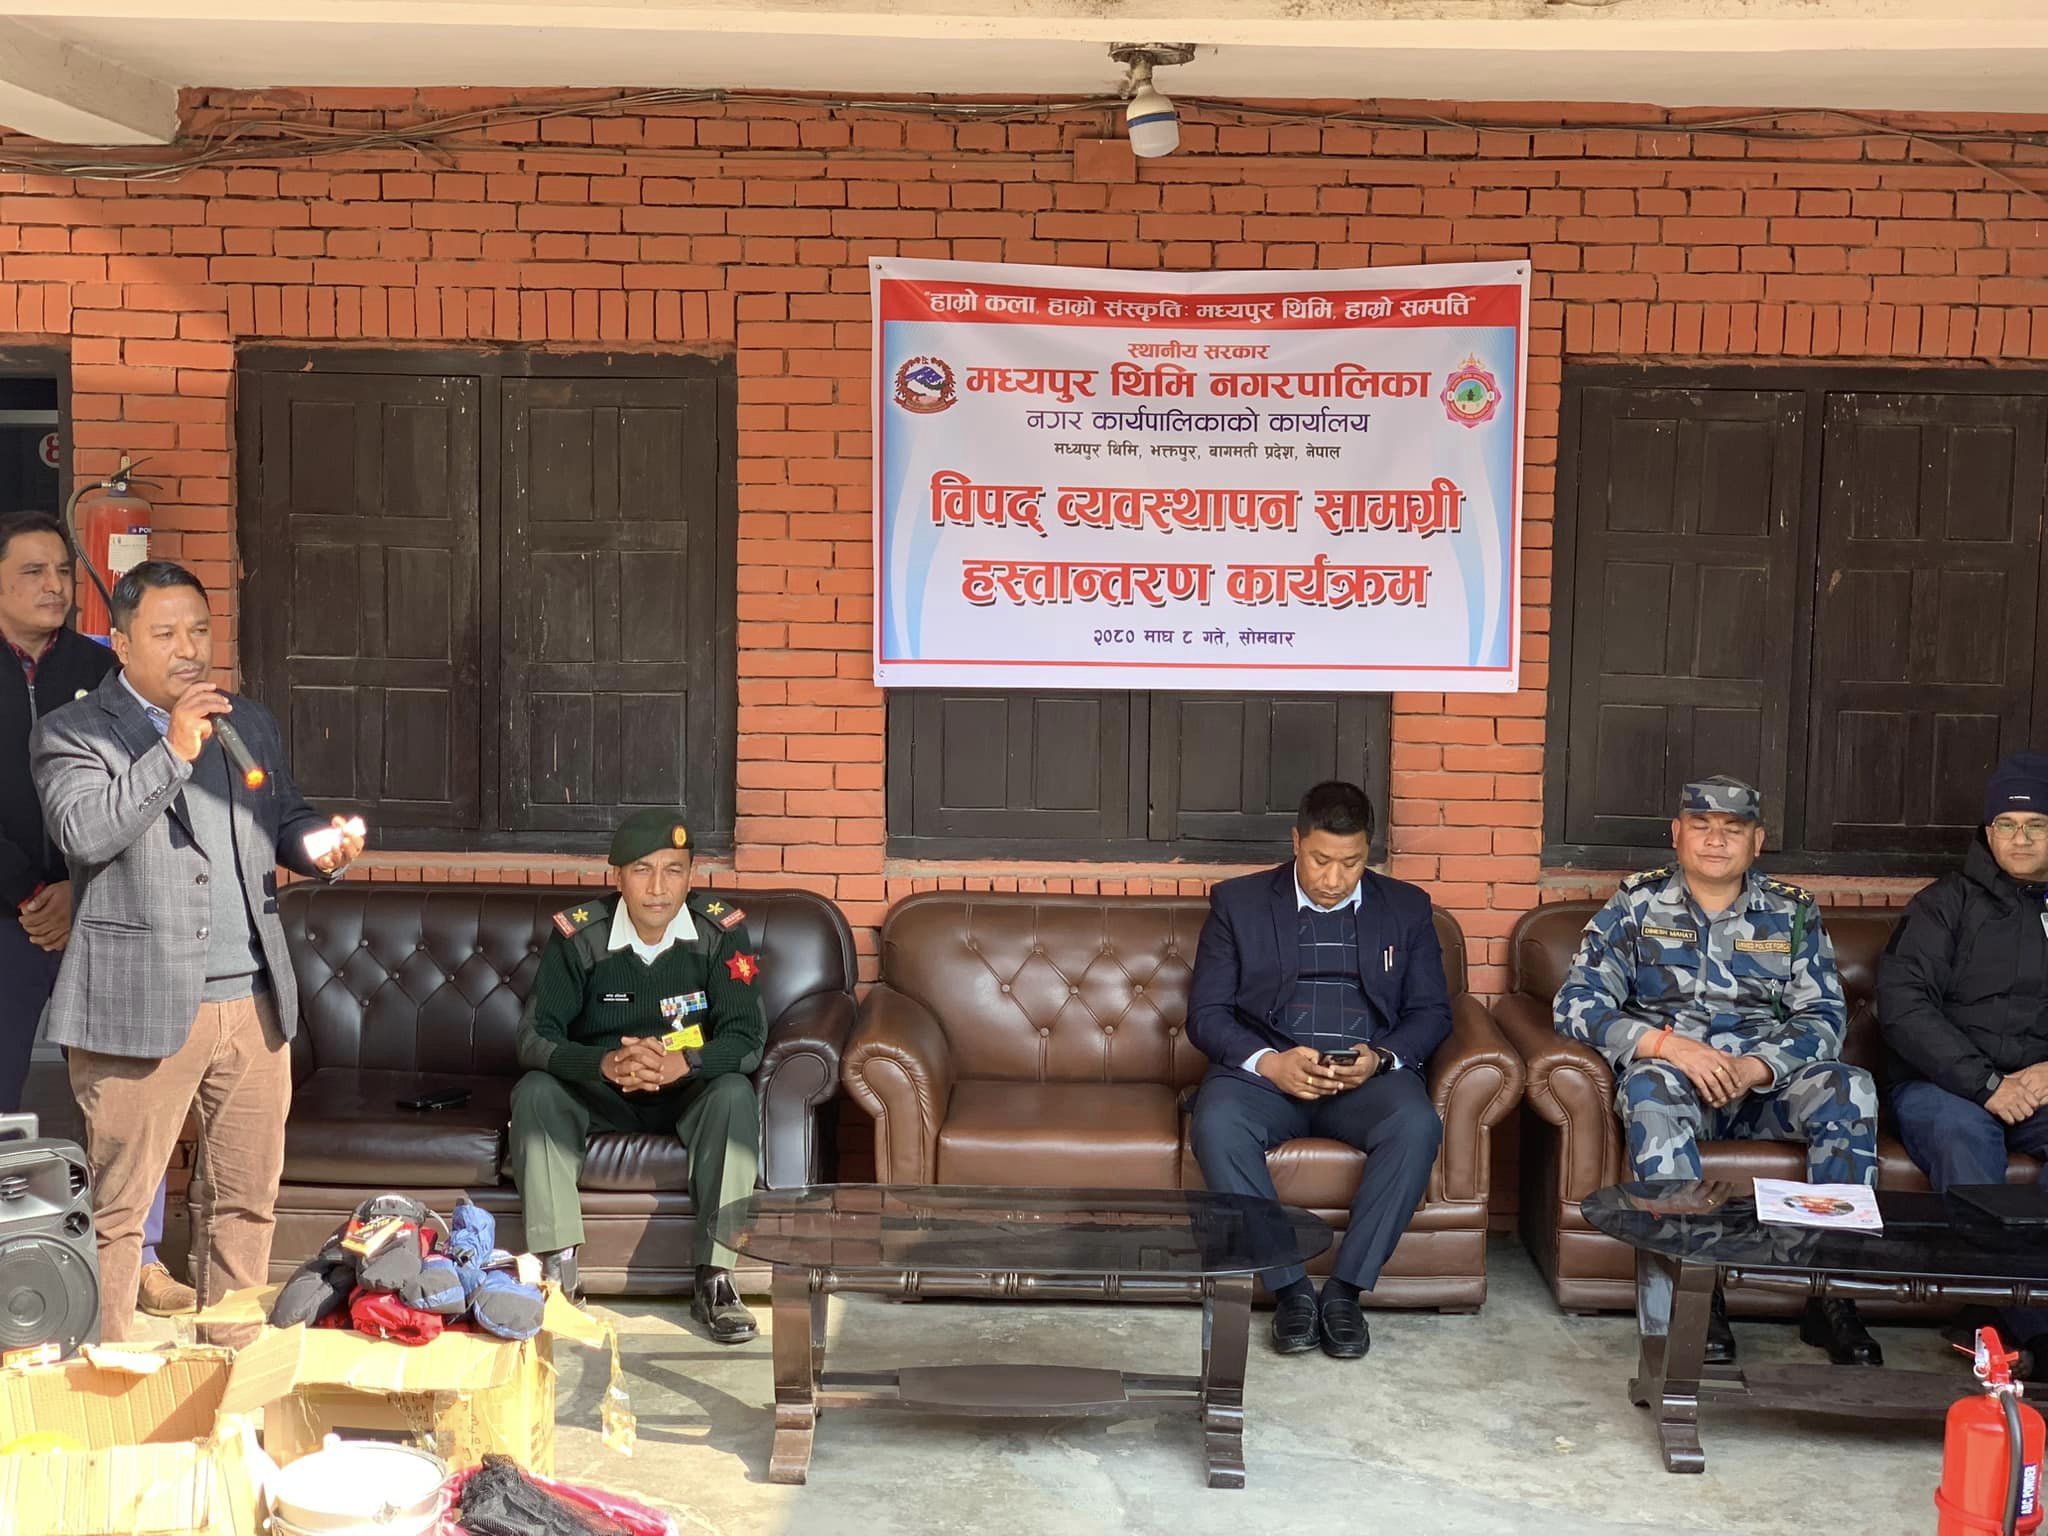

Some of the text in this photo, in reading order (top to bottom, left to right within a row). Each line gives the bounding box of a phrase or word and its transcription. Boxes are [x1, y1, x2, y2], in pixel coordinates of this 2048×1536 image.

[1047, 296, 1096, 317] हाम्रो
[1196, 303, 1275, 324] मध्यपुर
[1344, 296, 1394, 320] हाम्रो
[1127, 339, 1270, 360] स्थानीय सरकार
[966, 367, 1099, 404] मध्यपुर
[1110, 361, 1198, 398] थिमि
[1209, 362, 1432, 400] नगरपालिका
[1026, 405, 1371, 433] नगर कार्यपालिकाको कार्यालय
[1054, 442, 1101, 460] मध्यपुर
[1305, 443, 1341, 460] नेपाल
[930, 470, 1466, 539] विपद् व्यवस्थापन सामग्री
[962, 553, 1432, 611] हस्तान्तरण कार्यक्रम
[1094, 627, 1296, 648] २०८० माघ ८ गते, सोमबार
